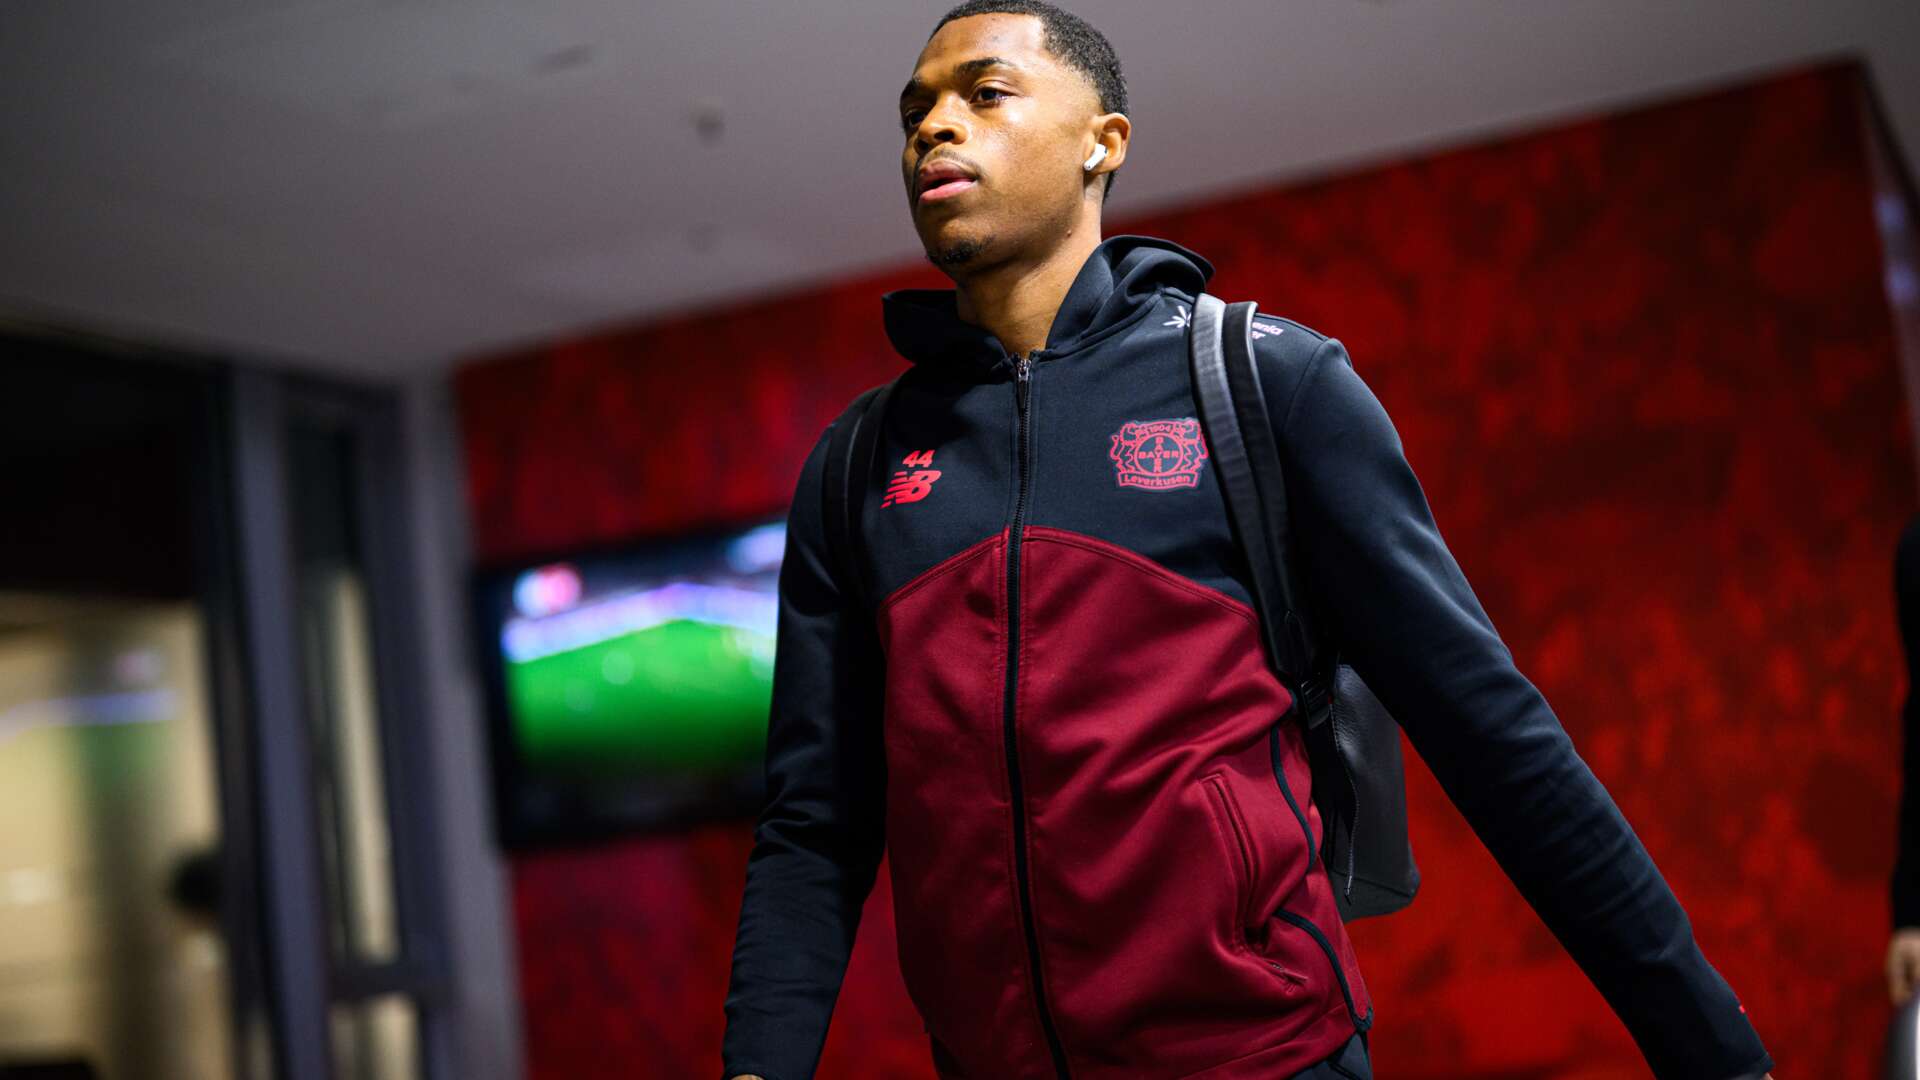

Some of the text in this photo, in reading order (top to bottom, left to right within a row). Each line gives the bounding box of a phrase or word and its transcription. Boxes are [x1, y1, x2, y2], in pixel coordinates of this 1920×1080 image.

[1150, 424, 1172, 433] 1904
[902, 449, 935, 468] 44
[1138, 450, 1179, 459] BAYER
[1124, 474, 1191, 486] Leverkusen
